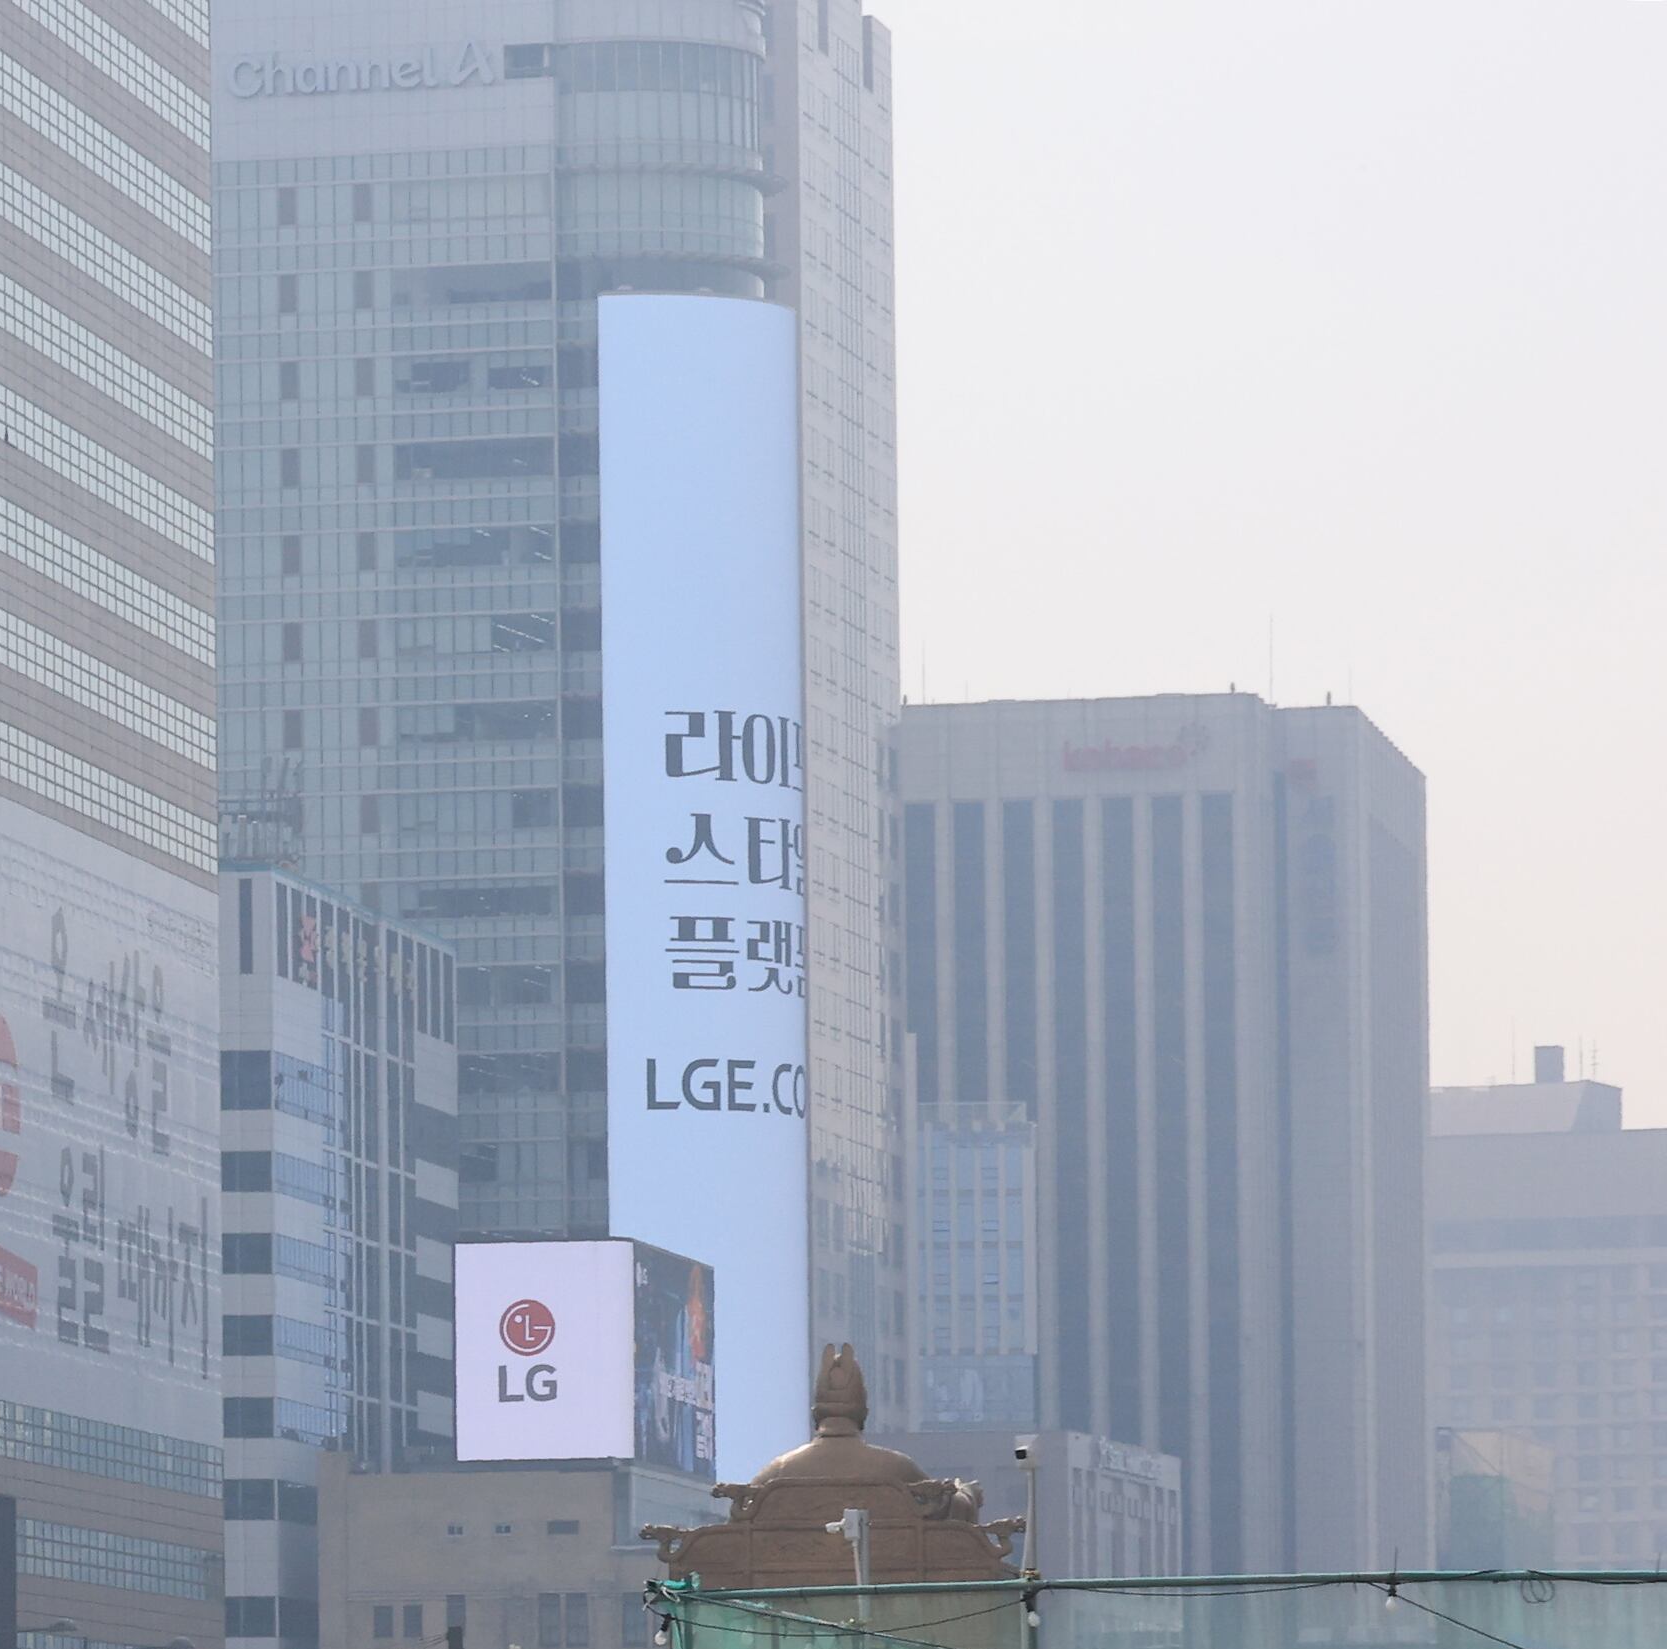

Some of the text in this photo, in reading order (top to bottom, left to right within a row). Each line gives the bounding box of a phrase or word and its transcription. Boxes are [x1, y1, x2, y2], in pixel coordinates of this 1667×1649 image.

[227, 40, 496, 100] Channel A
[41, 905, 77, 1106] 온
[82, 949, 172, 1157] 세상을
[4, 1267, 36, 1311] WORLD
[52, 1144, 210, 1380] 울릴 때까지
[498, 1364, 558, 1402] LG
